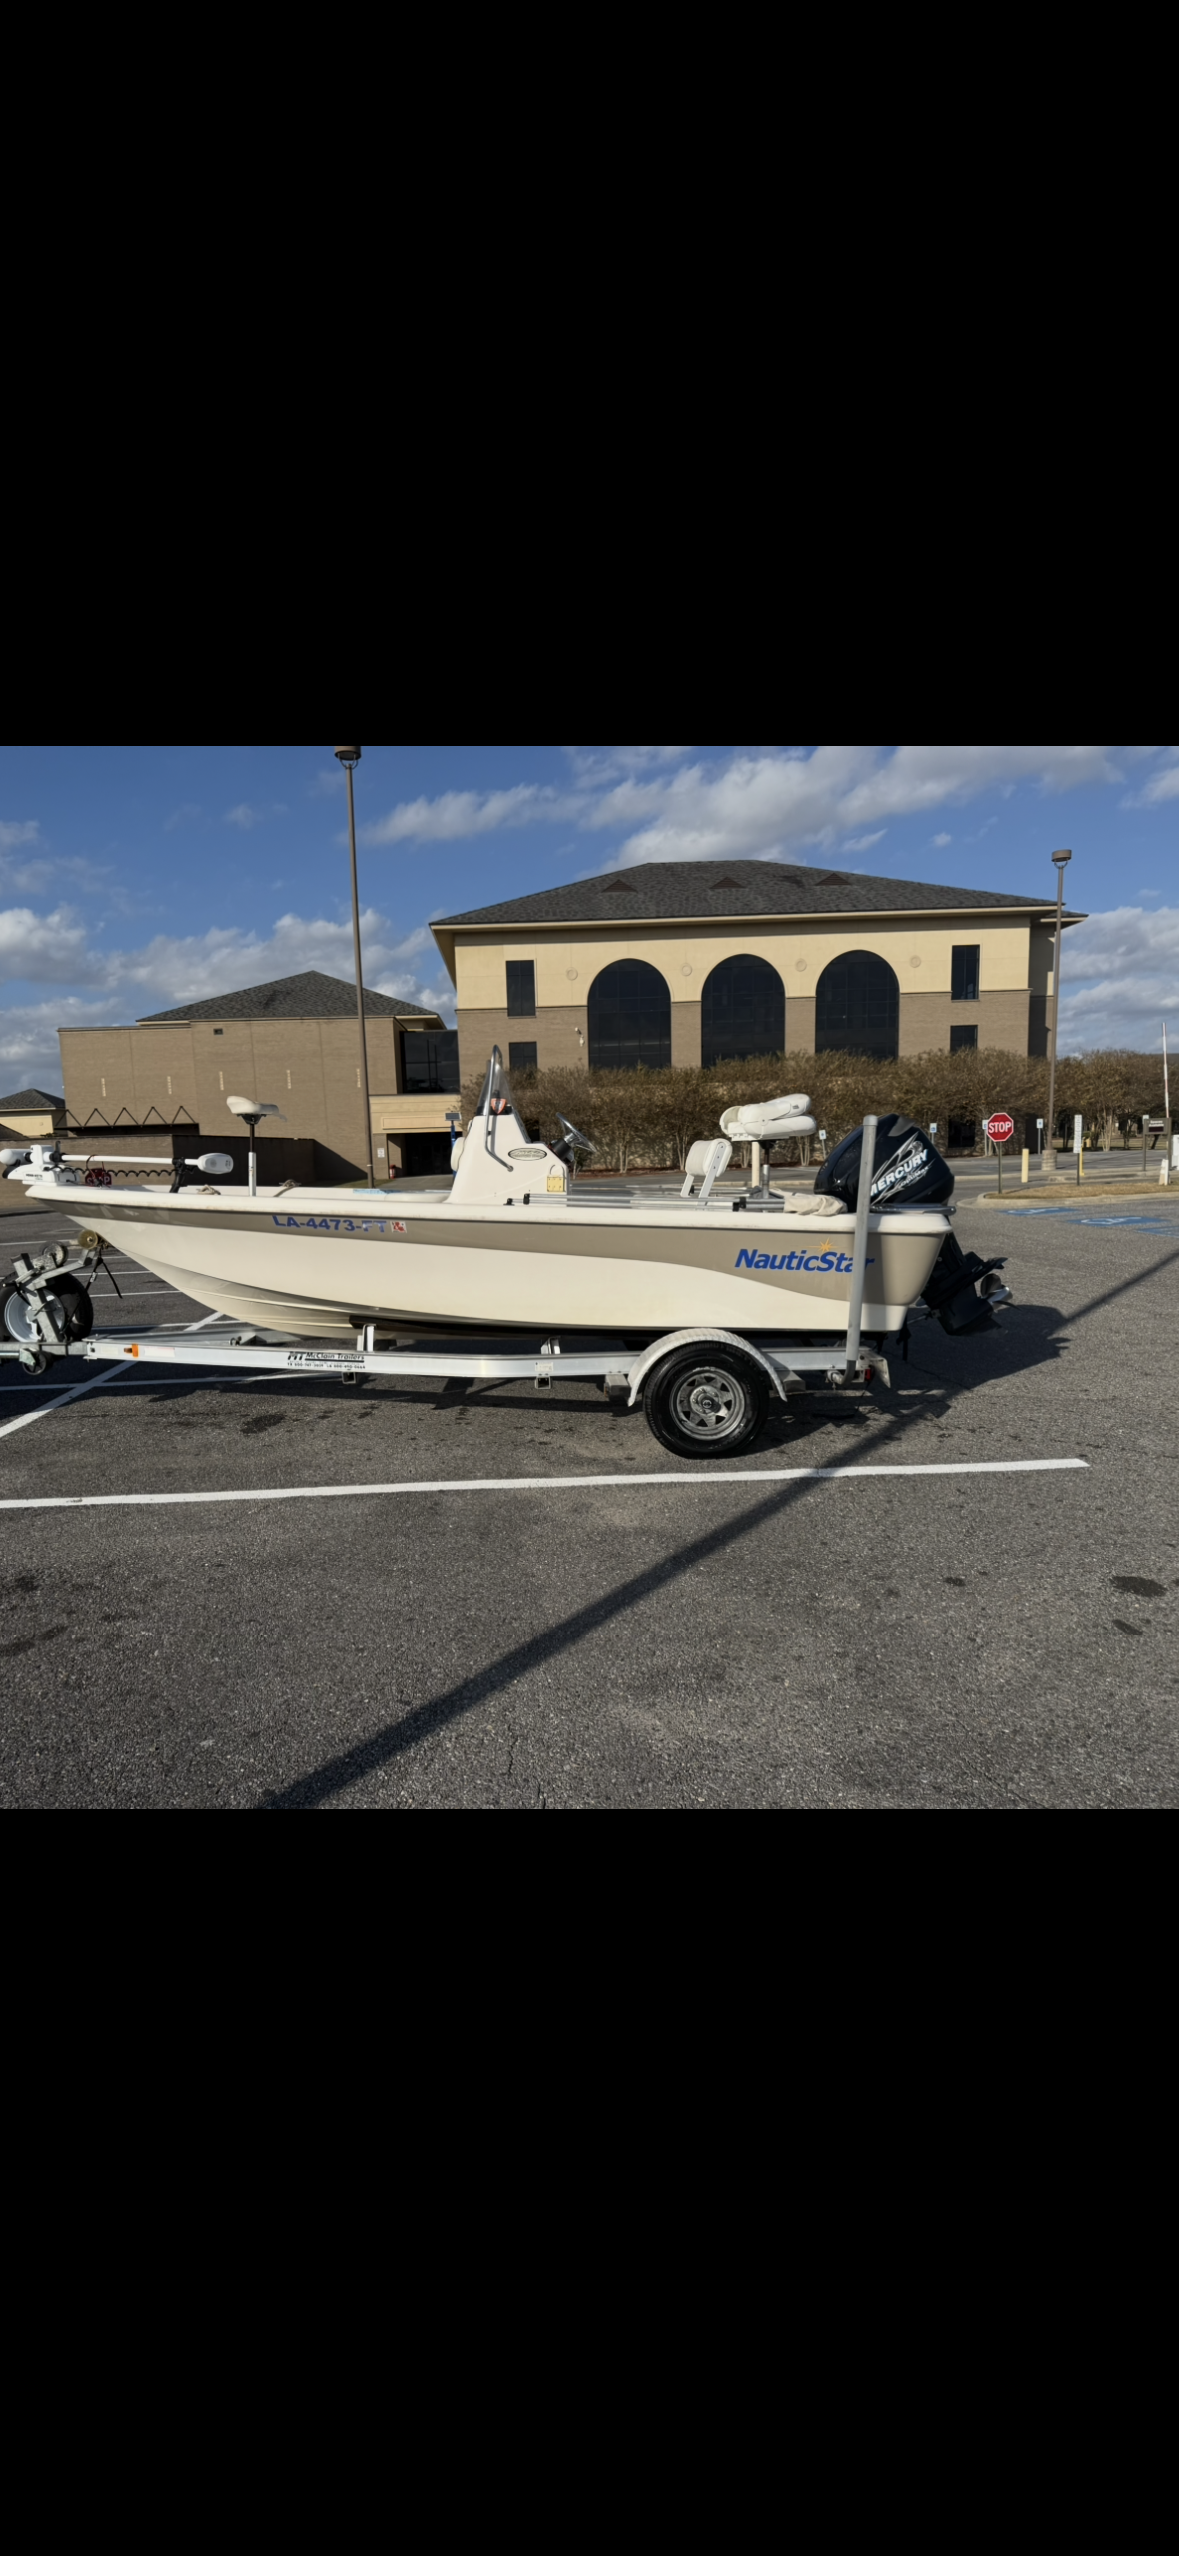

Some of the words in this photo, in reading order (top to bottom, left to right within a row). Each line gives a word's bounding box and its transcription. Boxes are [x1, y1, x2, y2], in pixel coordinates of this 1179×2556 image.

[988, 1121, 1012, 1133] STOP
[870, 1148, 929, 1197] MERCURY
[272, 1215, 387, 1233] LA-4473-FT
[734, 1248, 876, 1273] NauticStar
